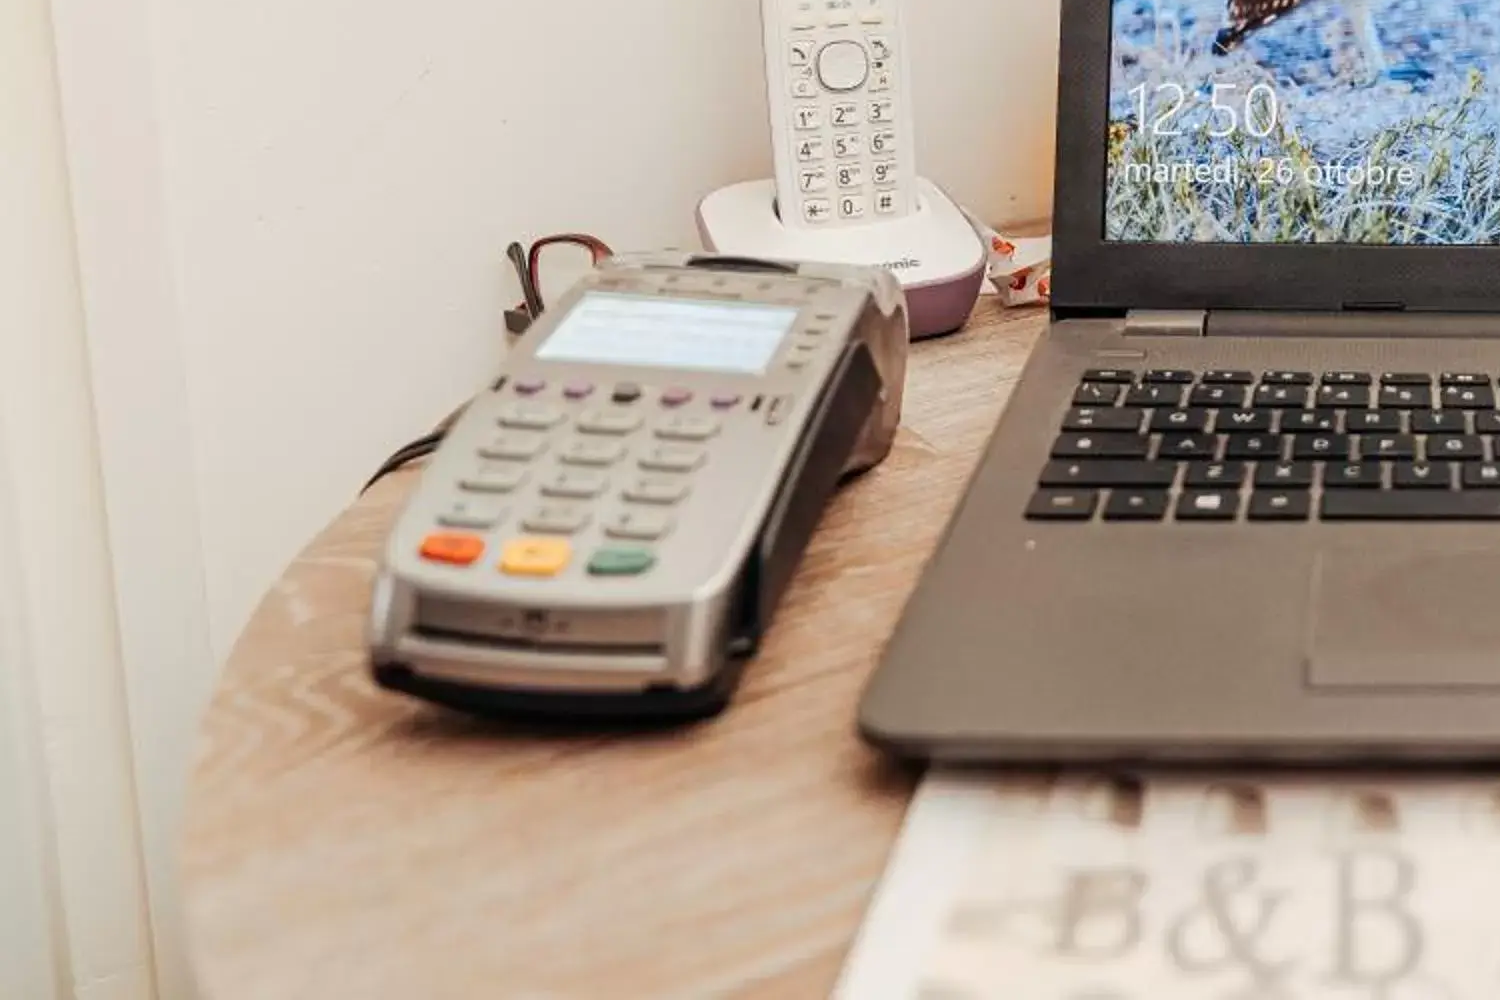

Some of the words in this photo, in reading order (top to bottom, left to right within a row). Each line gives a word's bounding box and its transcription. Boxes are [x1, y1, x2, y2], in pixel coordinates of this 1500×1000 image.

[835, 107, 846, 123] 2
[872, 103, 881, 119] 3
[1128, 82, 1278, 137] 12:50
[800, 142, 811, 157] 4
[836, 139, 847, 155] 5
[873, 134, 884, 150] 6
[803, 173, 814, 188] 7
[839, 169, 850, 185] 8
[875, 165, 887, 181] 9
[1257, 157, 1294, 185] 26
[1304, 157, 1415, 185] ottobre
[843, 199, 853, 215] 0
[1048, 848, 1426, 986] B&B
